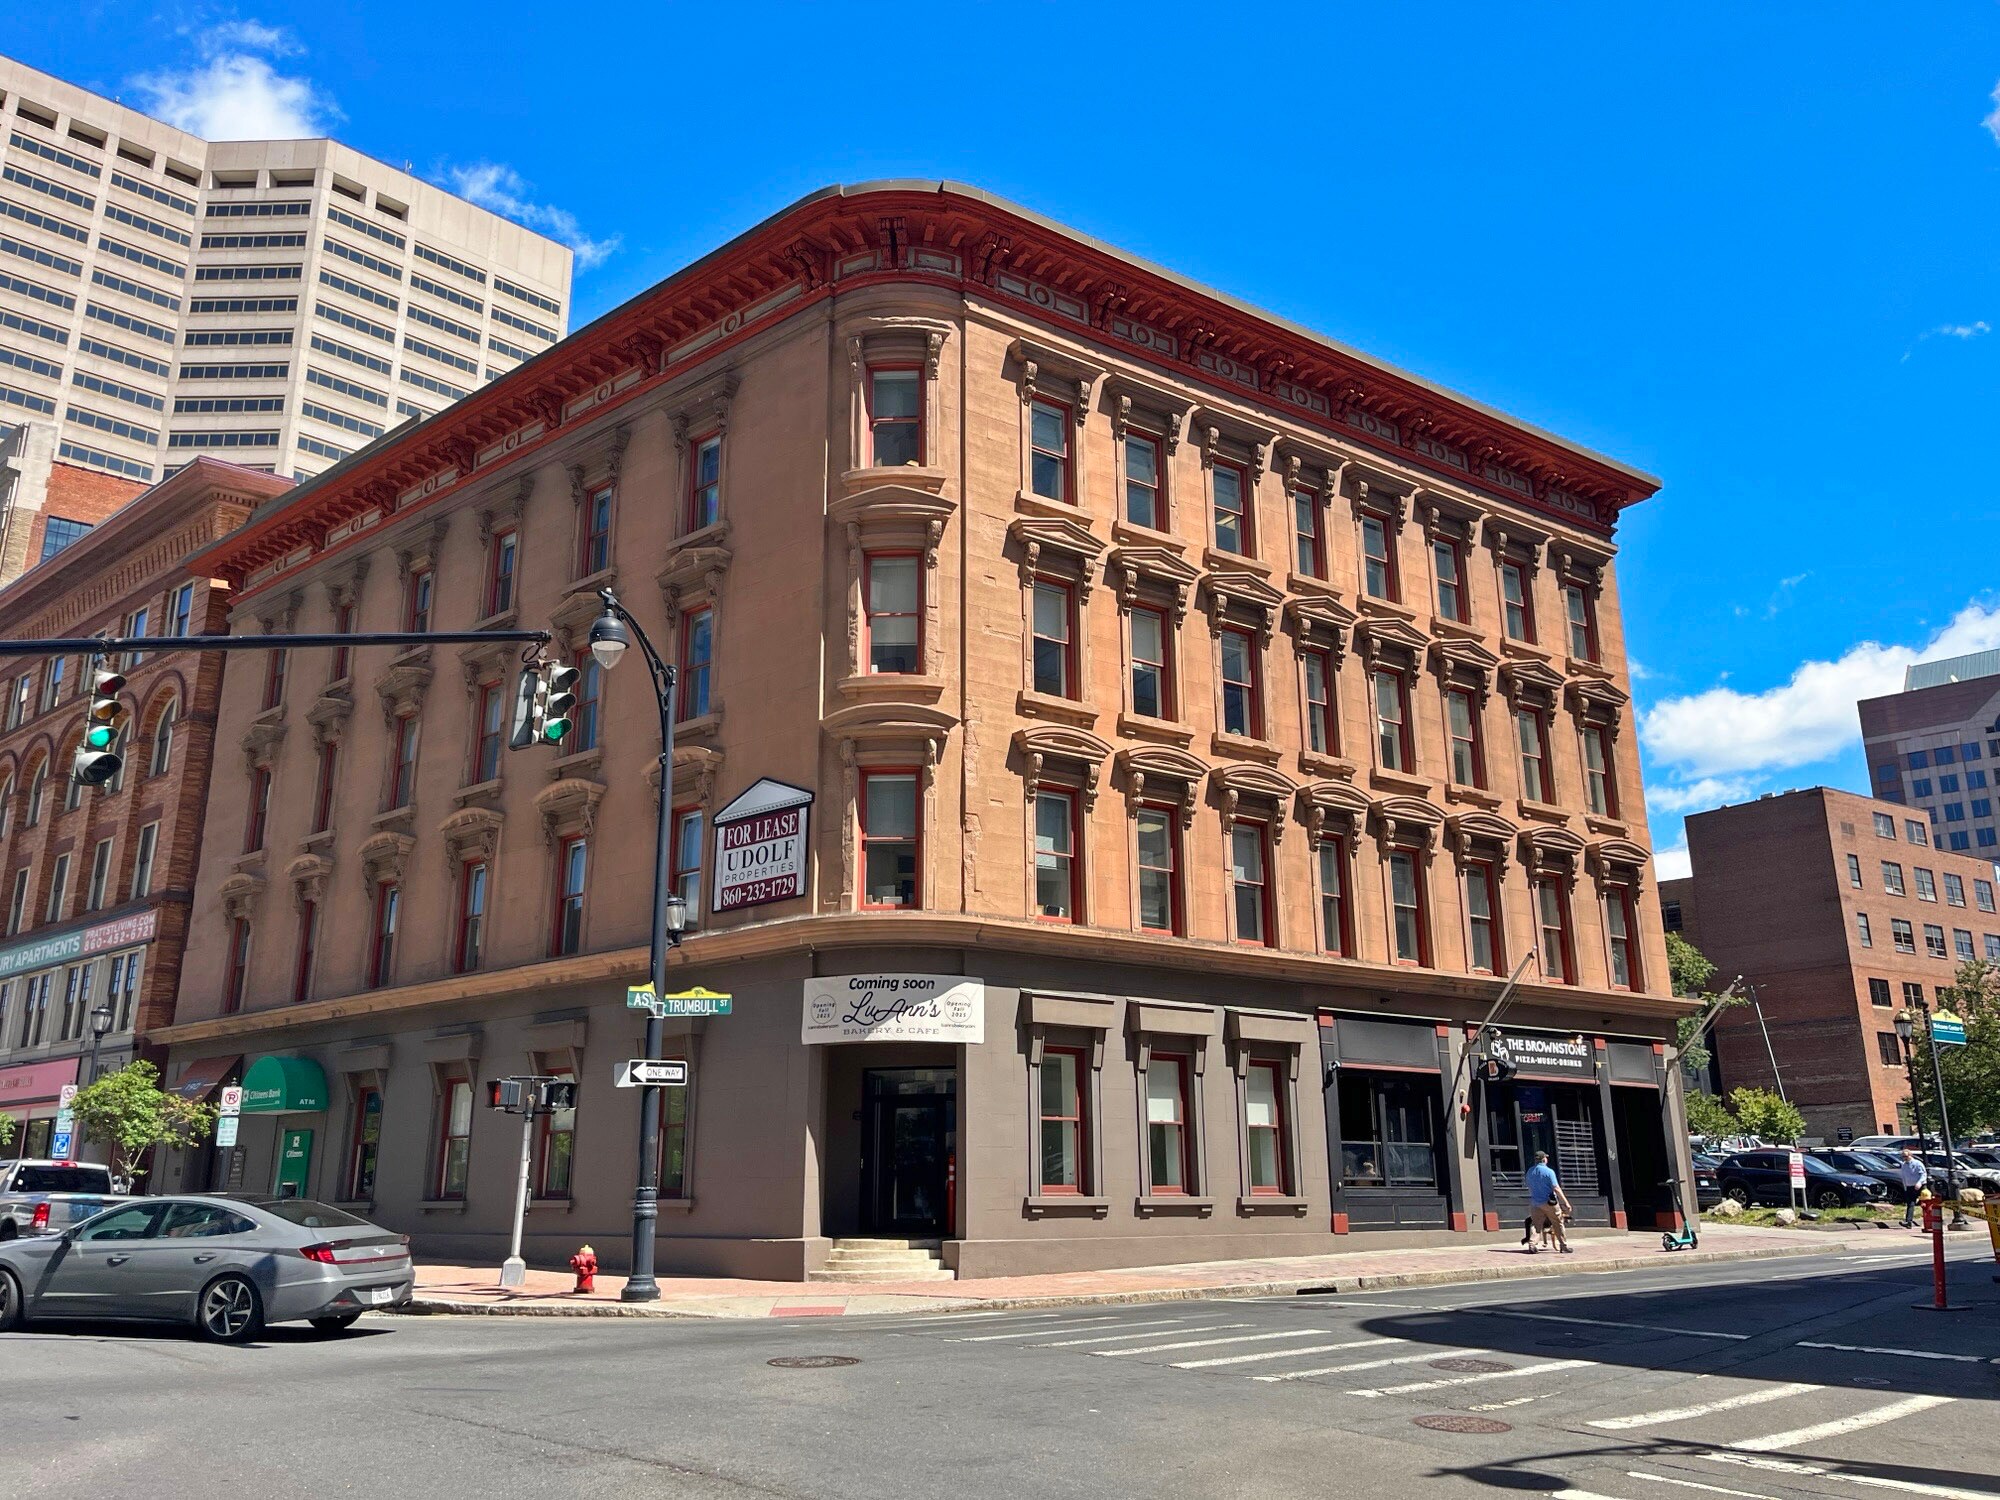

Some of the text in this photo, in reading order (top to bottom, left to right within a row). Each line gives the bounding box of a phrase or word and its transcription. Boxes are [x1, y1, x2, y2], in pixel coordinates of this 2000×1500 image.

[726, 813, 797, 848] FOR LEASE
[728, 839, 794, 871] UDOLF
[725, 862, 794, 883] PROPERTIES
[723, 877, 794, 906] 860-232-1729
[85, 913, 156, 938] PRATTSTLIVING.COM
[84, 925, 154, 951] 860-452-6721
[15, 936, 80, 967] APARTMENTS
[849, 976, 935, 991] Coming soon
[668, 999, 718, 1012] TRUMBULL
[842, 991, 941, 1026] LuAnn's
[946, 1001, 971, 1009] Opening
[843, 1027, 892, 1036] BAKERY
[908, 1027, 939, 1035] CAFE
[1506, 1038, 1588, 1056] THE BROWNSTONE
[646, 1068, 680, 1077] ONE WAY
[250, 1088, 281, 1099] Citizens Bank
[286, 1150, 303, 1158] Citizens
